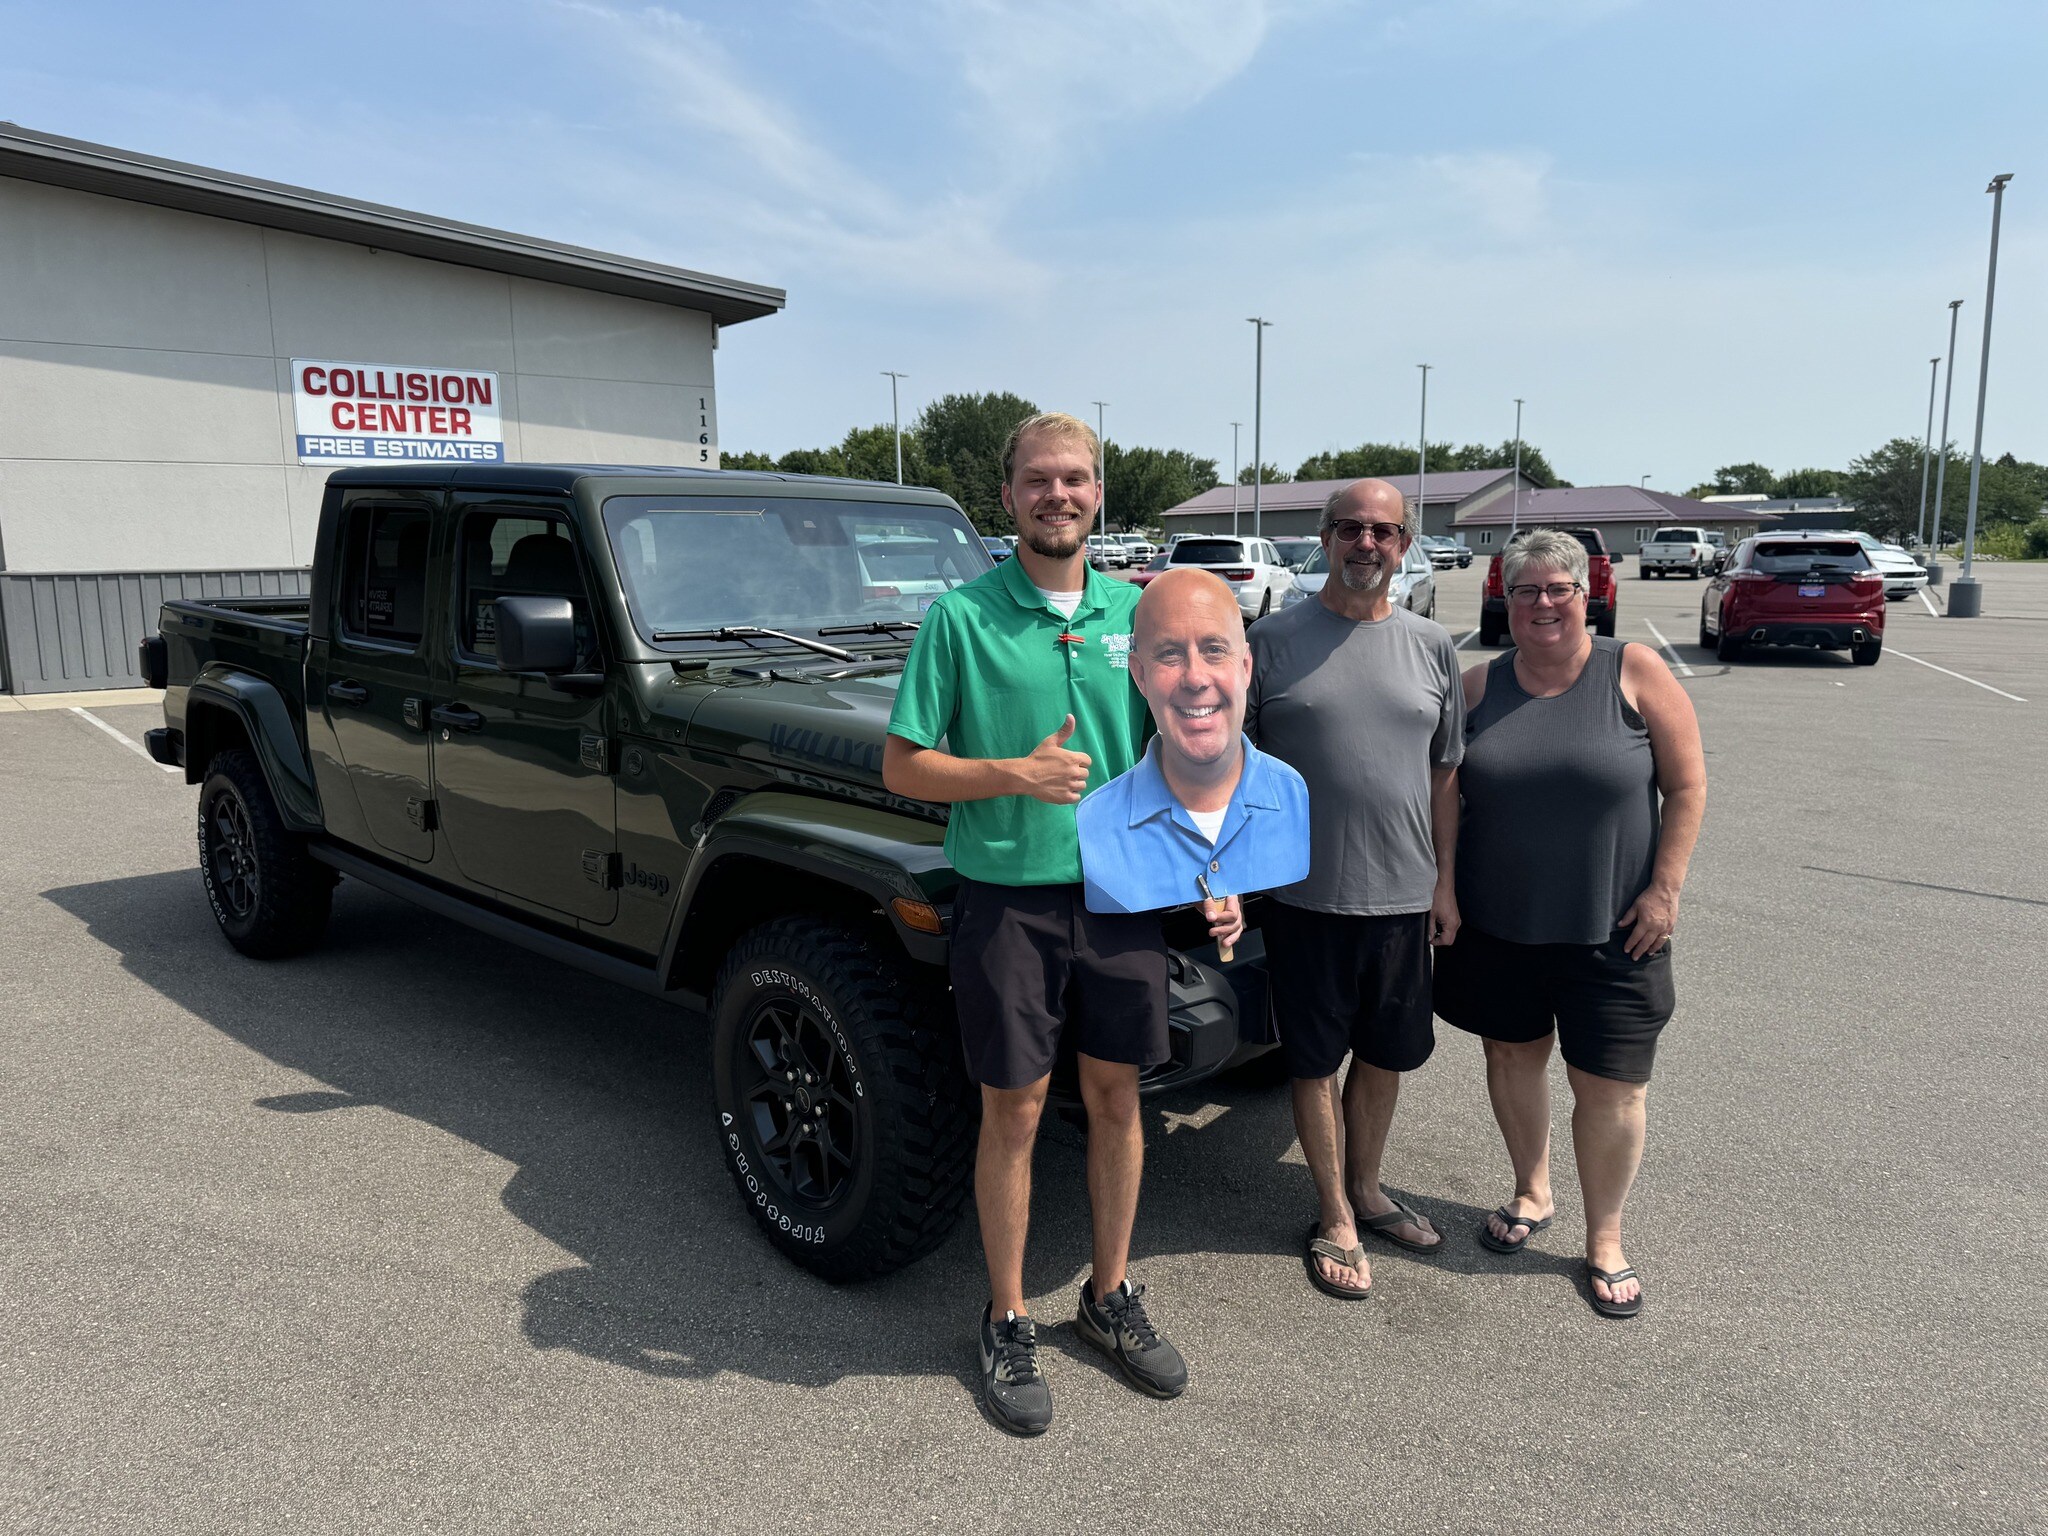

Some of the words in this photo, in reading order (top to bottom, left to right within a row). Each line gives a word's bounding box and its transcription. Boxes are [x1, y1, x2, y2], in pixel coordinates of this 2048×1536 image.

[302, 366, 492, 405] COLLISION
[331, 401, 472, 435] CENTER
[699, 397, 708, 462] 1165
[304, 437, 366, 456] FREE
[373, 439, 498, 460] ESTIMATES
[624, 862, 670, 897] Jeep
[751, 969, 857, 1074] DESTINATION
